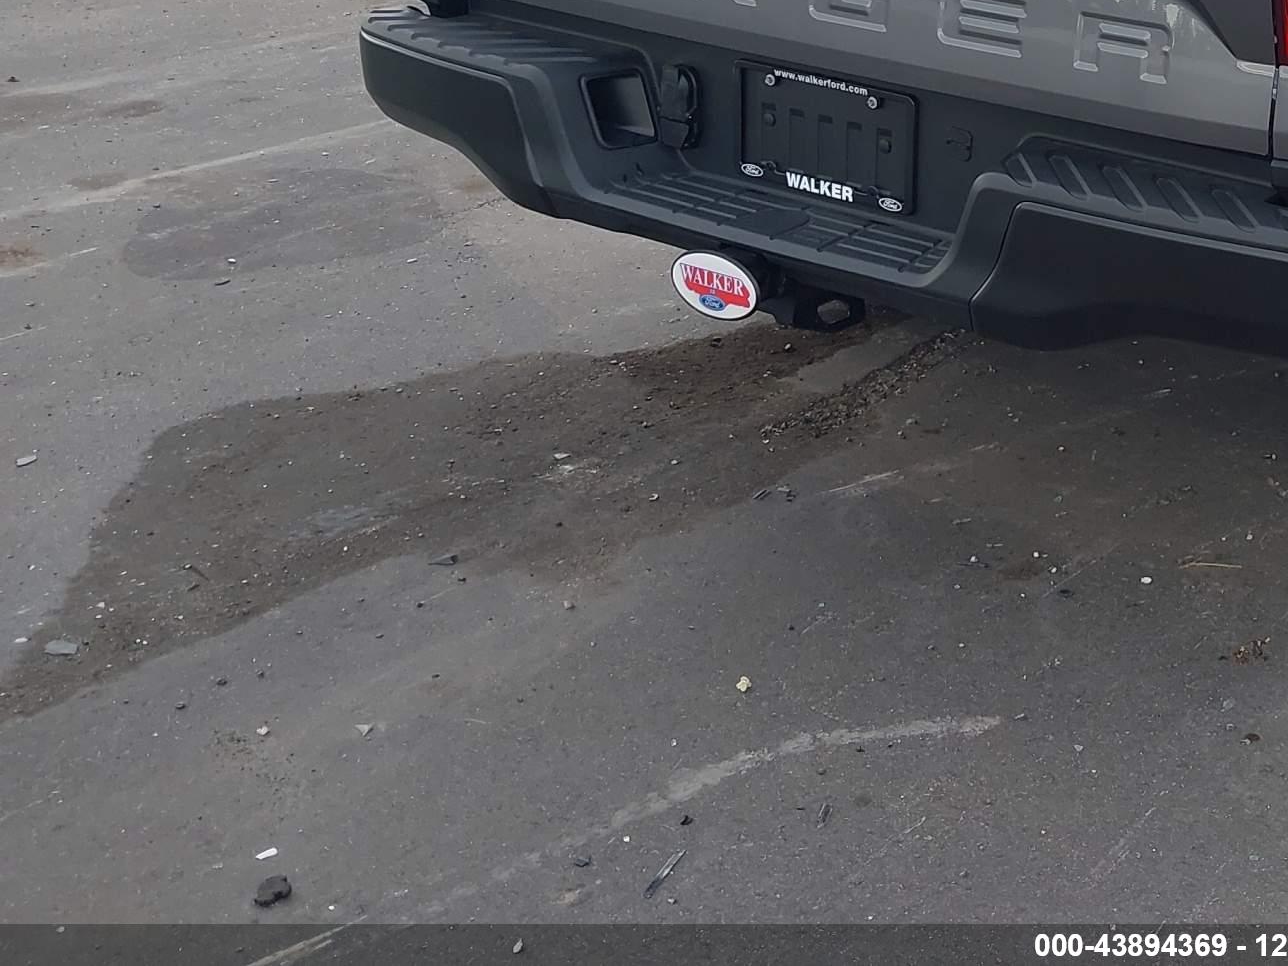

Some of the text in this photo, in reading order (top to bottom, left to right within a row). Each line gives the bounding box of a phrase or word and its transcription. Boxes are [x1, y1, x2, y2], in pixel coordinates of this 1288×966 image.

[773, 69, 868, 95] www.walkerford.com
[786, 171, 853, 202] WALKER
[680, 263, 744, 297] WALKER
